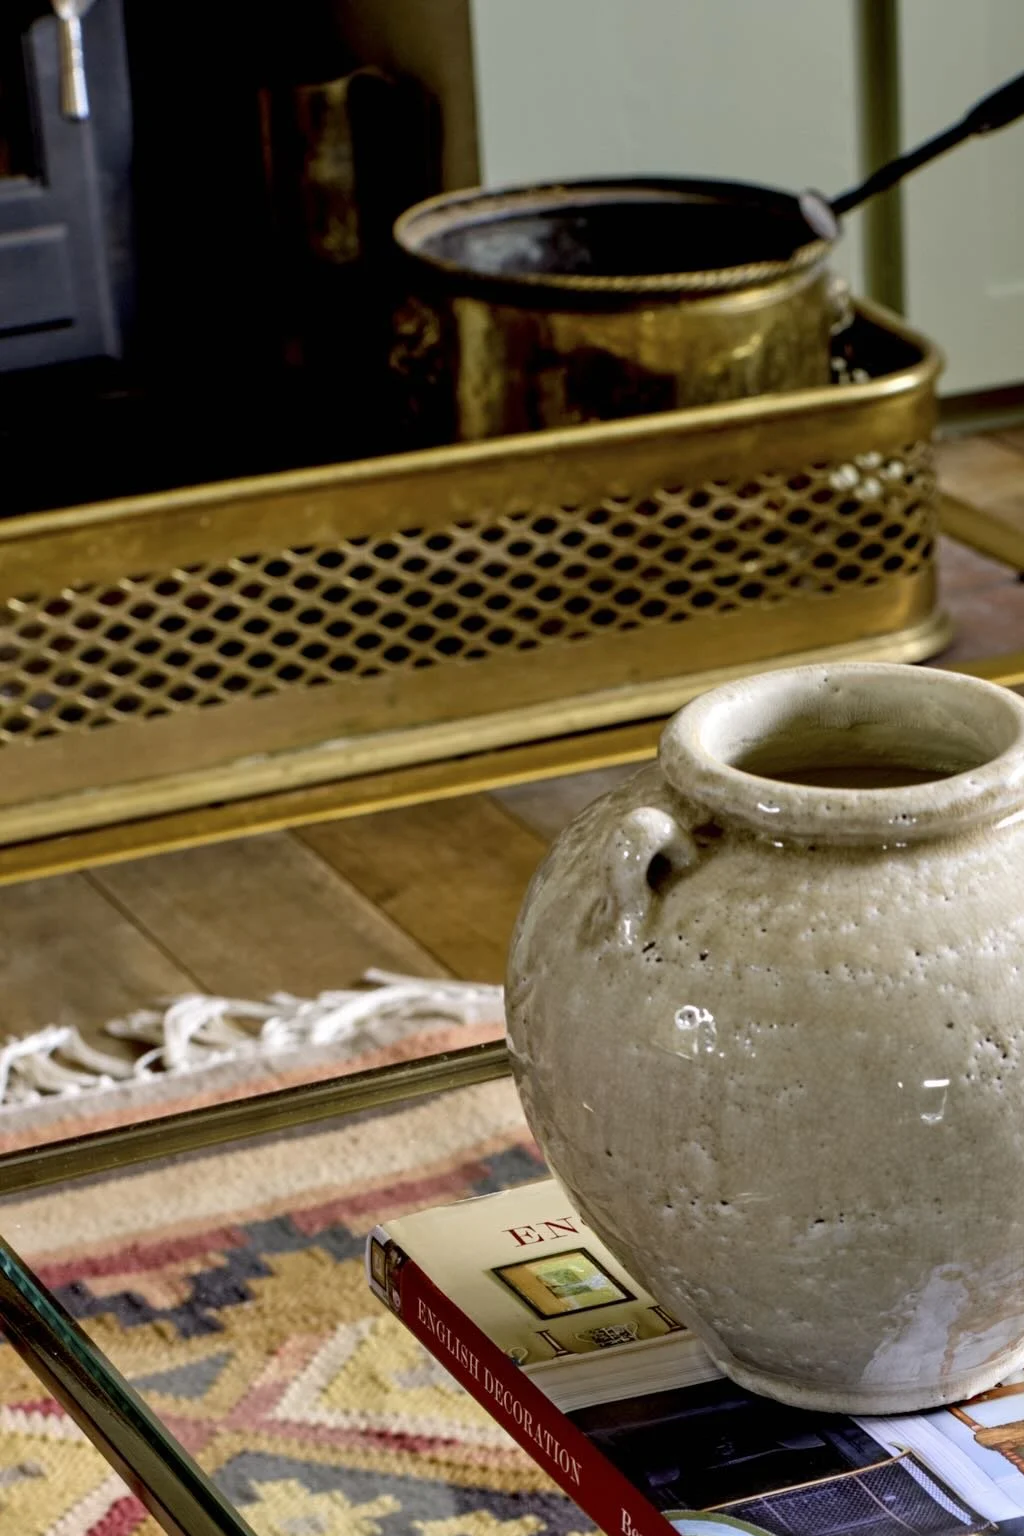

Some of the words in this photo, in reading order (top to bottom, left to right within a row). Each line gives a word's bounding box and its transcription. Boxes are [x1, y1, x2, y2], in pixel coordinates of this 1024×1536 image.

[501, 1216, 584, 1248] EN
[417, 1297, 480, 1381] ENGLISH
[484, 1366, 583, 1487] DECORATION
